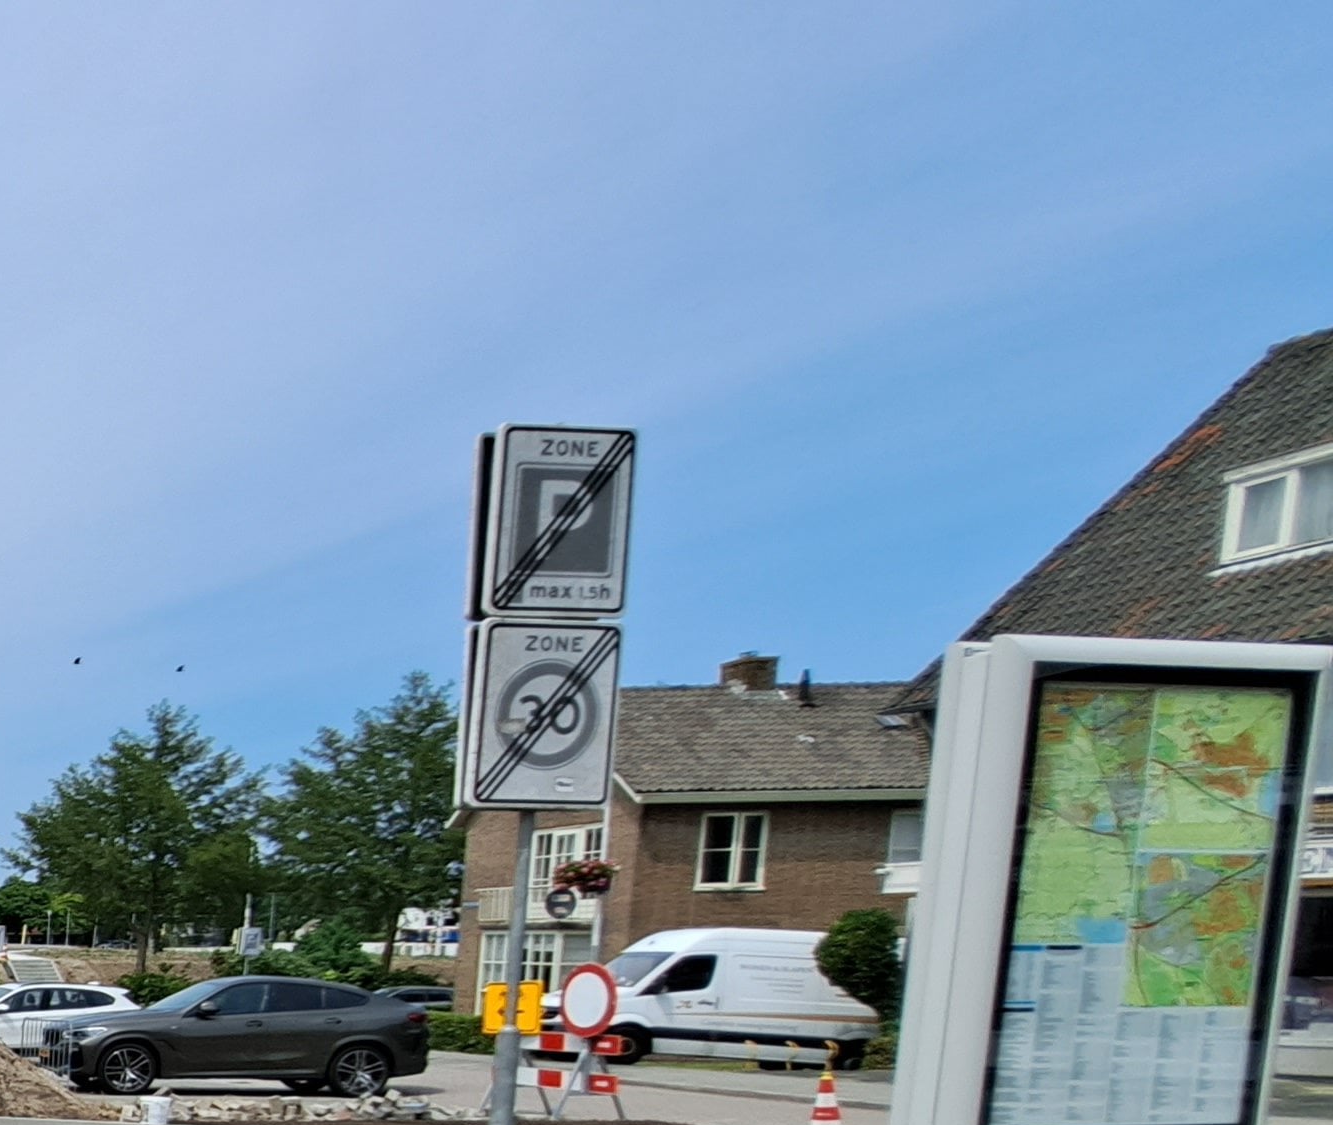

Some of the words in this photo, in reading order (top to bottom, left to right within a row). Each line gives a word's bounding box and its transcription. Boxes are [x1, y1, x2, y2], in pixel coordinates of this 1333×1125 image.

[541, 439, 599, 457] ZONE
[536, 479, 594, 560] P
[530, 584, 572, 599] max
[525, 635, 583, 652] ZONE
[519, 694, 580, 735] 30
